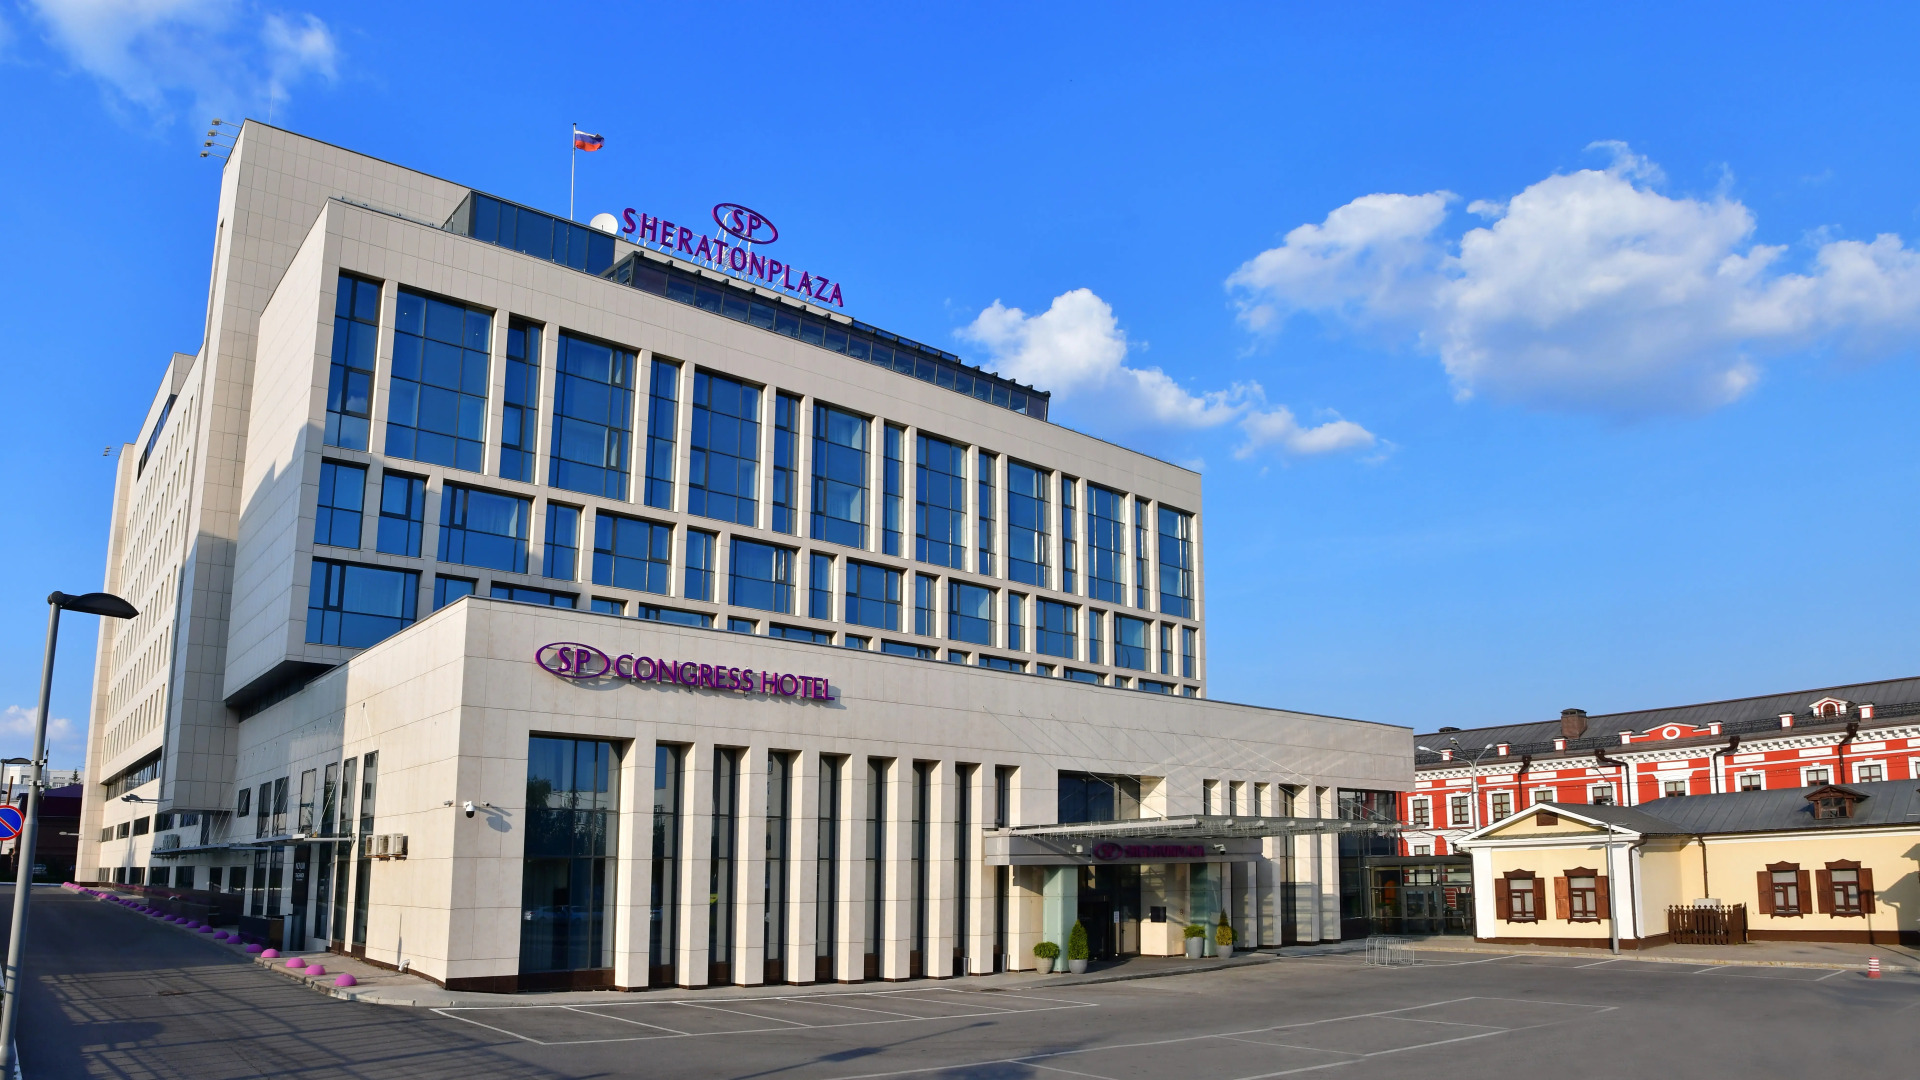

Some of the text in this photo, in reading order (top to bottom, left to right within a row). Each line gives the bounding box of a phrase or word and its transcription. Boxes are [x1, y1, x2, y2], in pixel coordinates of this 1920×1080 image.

[731, 209, 762, 238] SP
[556, 646, 836, 701] SP CONGRESS HOTEL
